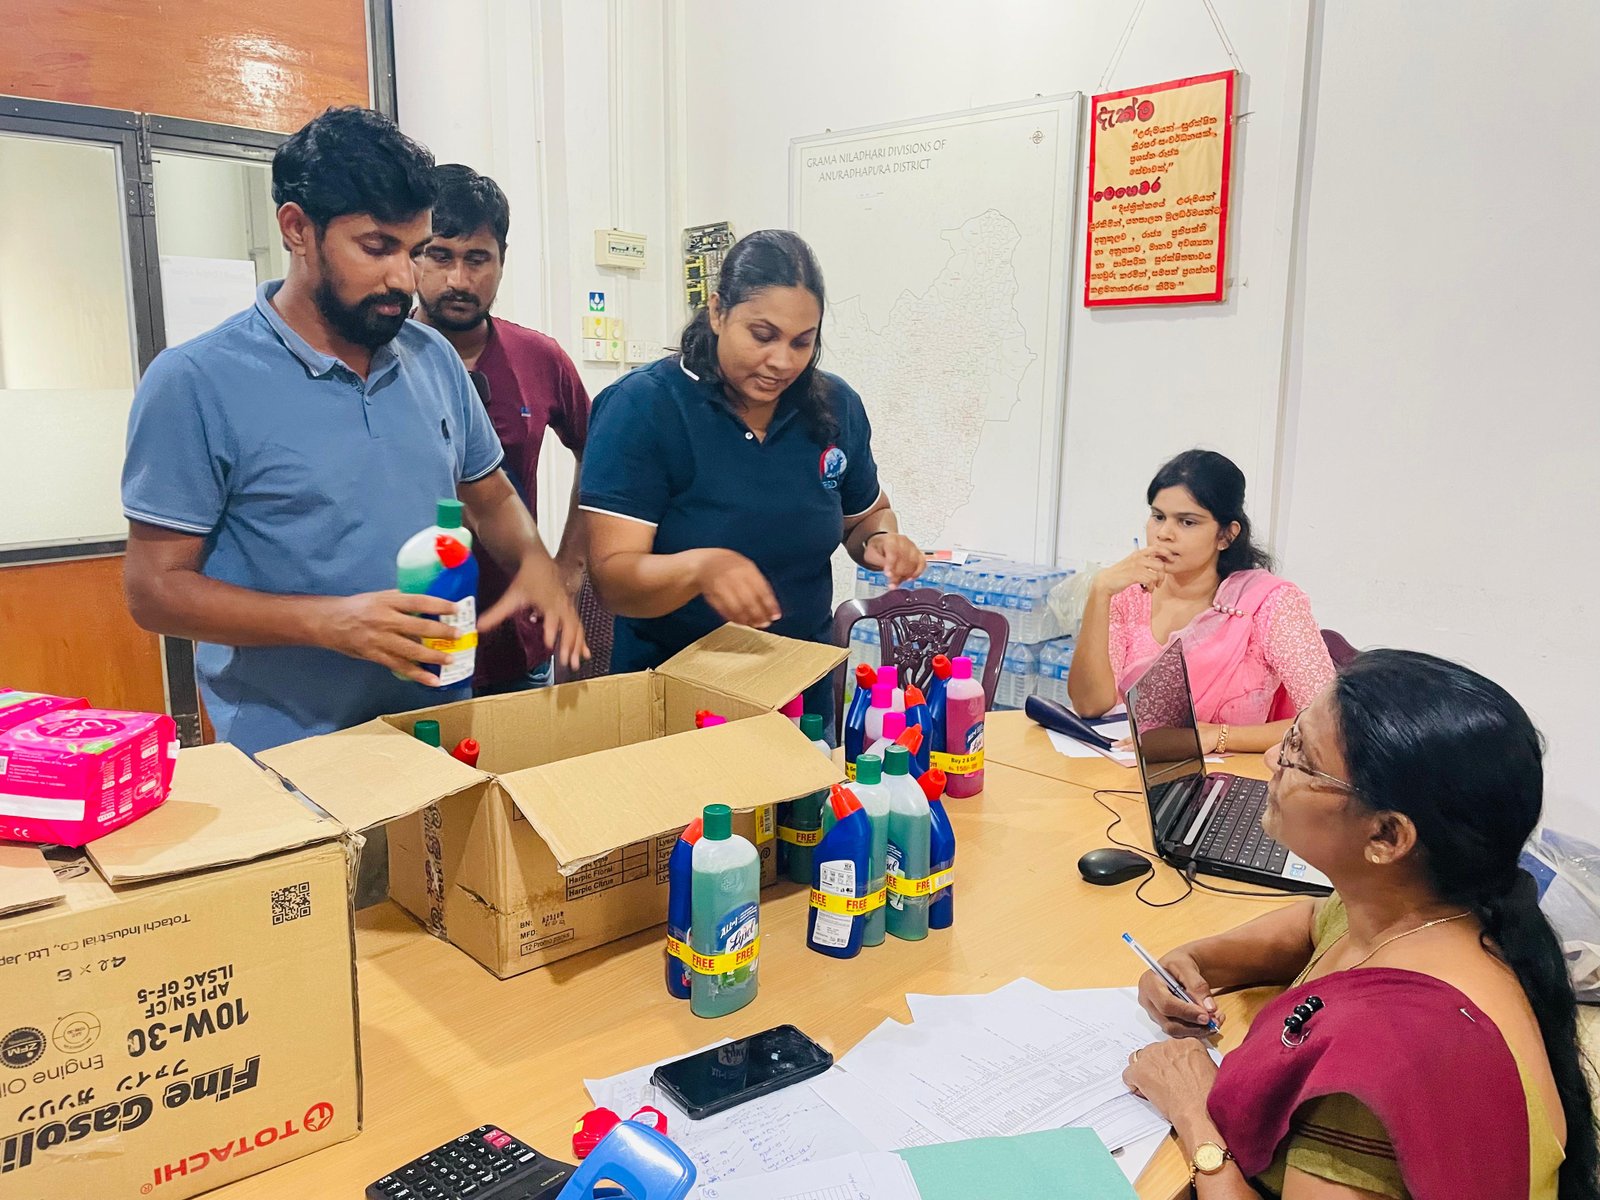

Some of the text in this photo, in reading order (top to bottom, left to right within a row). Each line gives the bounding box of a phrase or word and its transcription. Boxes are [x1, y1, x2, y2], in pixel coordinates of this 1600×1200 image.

[1096, 97, 1155, 131] දැක්ම
[806, 138, 948, 168] GRAMA NILADHARI DIVISIONS OF
[818, 158, 932, 182] ANURADHAPURA DISTRICT
[1094, 176, 1161, 202] මෙහෙවර
[796, 832, 816, 842] FREE
[568, 878, 614, 897] Harpic Citrus
[569, 866, 613, 884] Harpic Floral
[846, 899, 867, 909] FREE
[82, 925, 141, 948] Industrial
[143, 914, 191, 933] Totachi
[730, 918, 756, 952] Lysol
[24, 948, 50, 962] Ltd.
[692, 954, 715, 969] FREE
[736, 945, 754, 962] FREE
[137, 964, 233, 1004] ILSAC GF-5
[145, 981, 230, 1019] API SN/CF
[127, 998, 249, 1058] 10W-30
[32, 1054, 104, 1084] Engine
[17, 1058, 189, 1123] ファイン ガソリン
[0, 1054, 261, 1174] Fine Gasoli
[153, 1120, 299, 1186] TOTACHI
